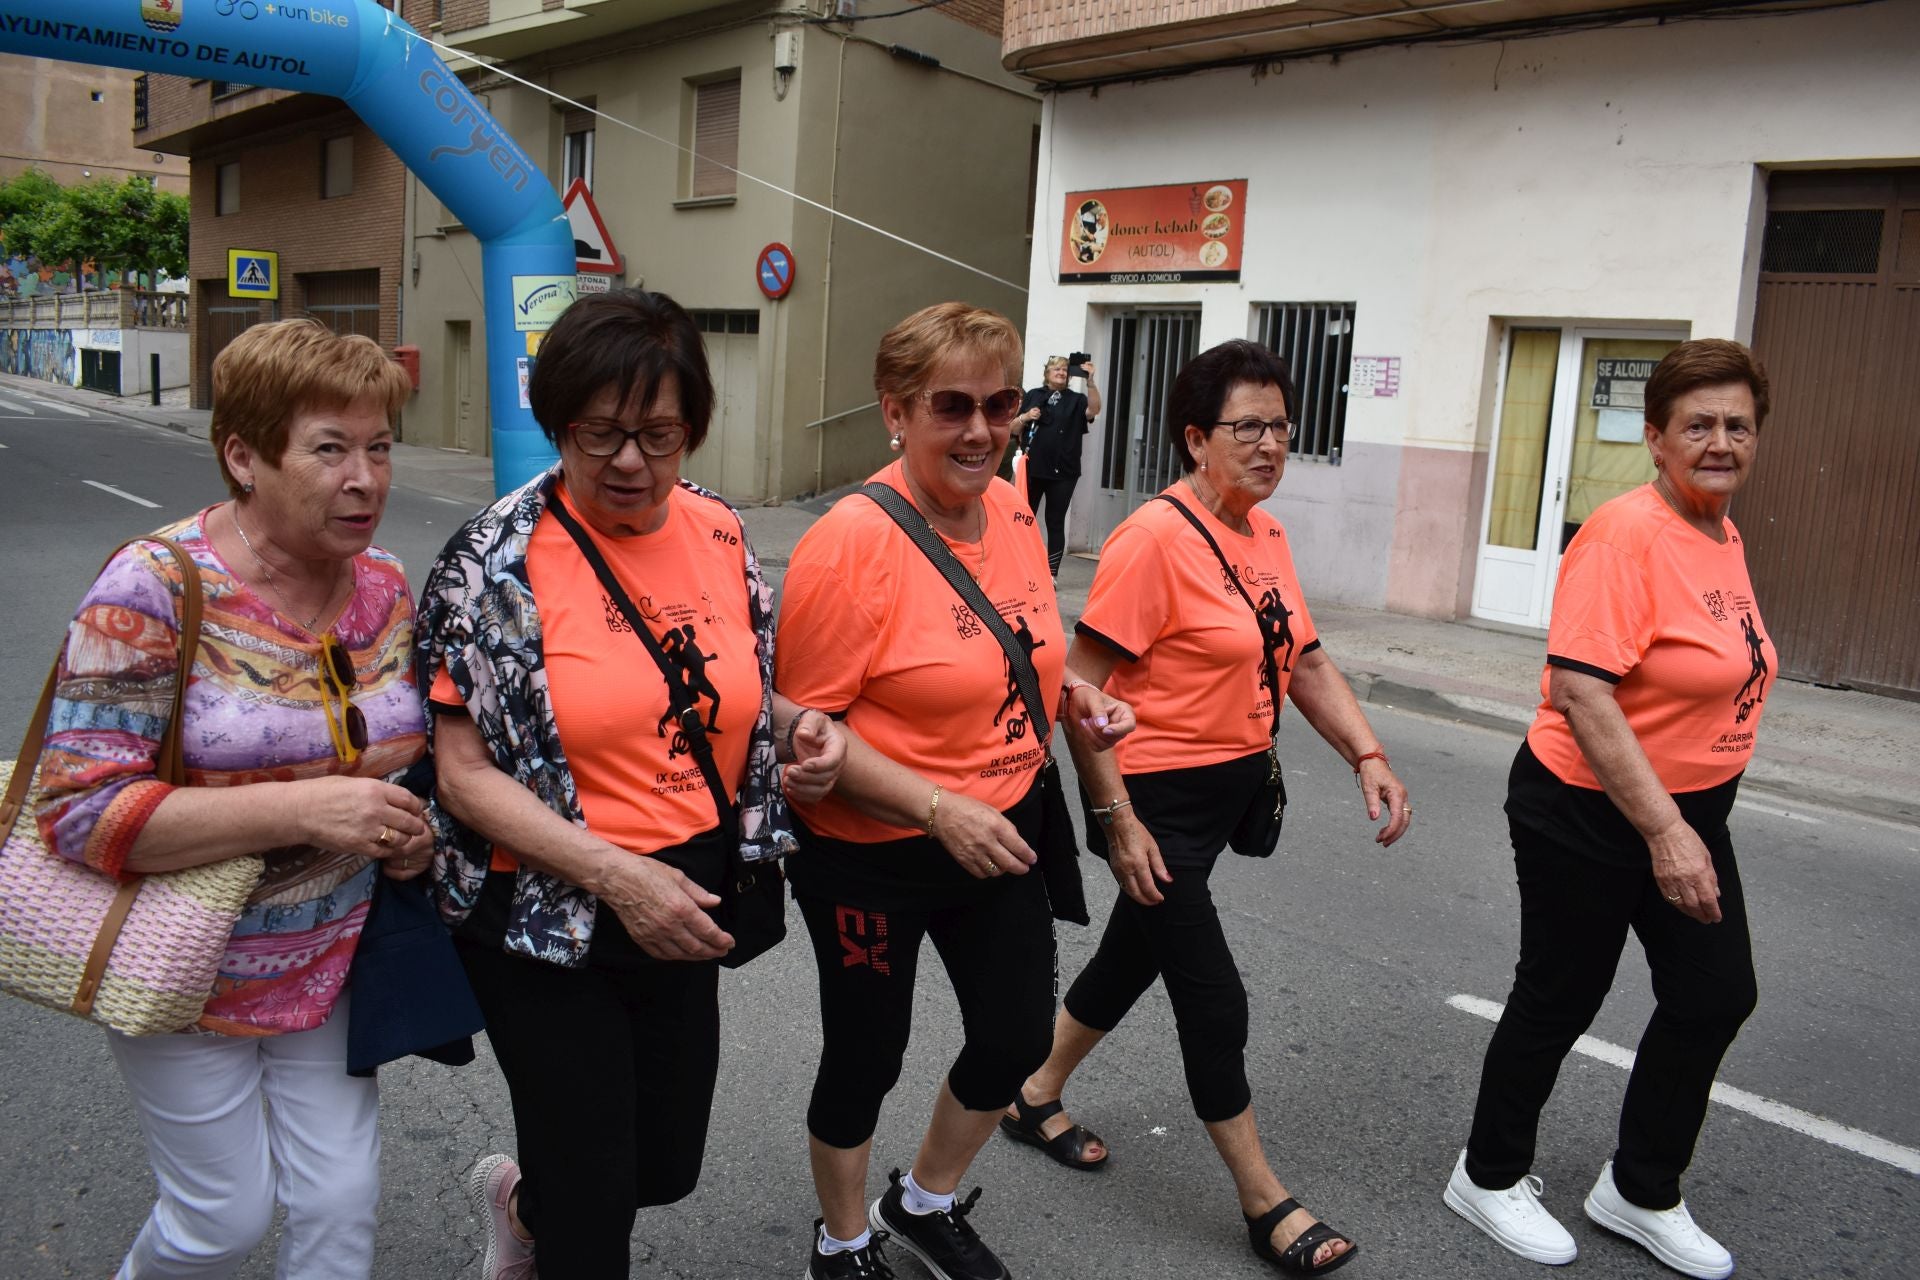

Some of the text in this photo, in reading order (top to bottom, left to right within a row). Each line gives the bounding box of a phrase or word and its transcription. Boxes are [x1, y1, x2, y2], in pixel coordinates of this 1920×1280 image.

[196, 44, 229, 64] DE
[233, 51, 310, 76] AUTOL
[1110, 219, 1198, 236] doner kebab
[1110, 273, 1181, 282] SERVICIO A DOMICILIO
[519, 285, 558, 315] Verona
[1598, 362, 1653, 378] SE ALQUIL
[990, 758, 1001, 768] IX
[656, 767, 701, 784] IX CARRE
[980, 767, 1014, 778] CONTRA
[686, 782, 696, 792] EL
